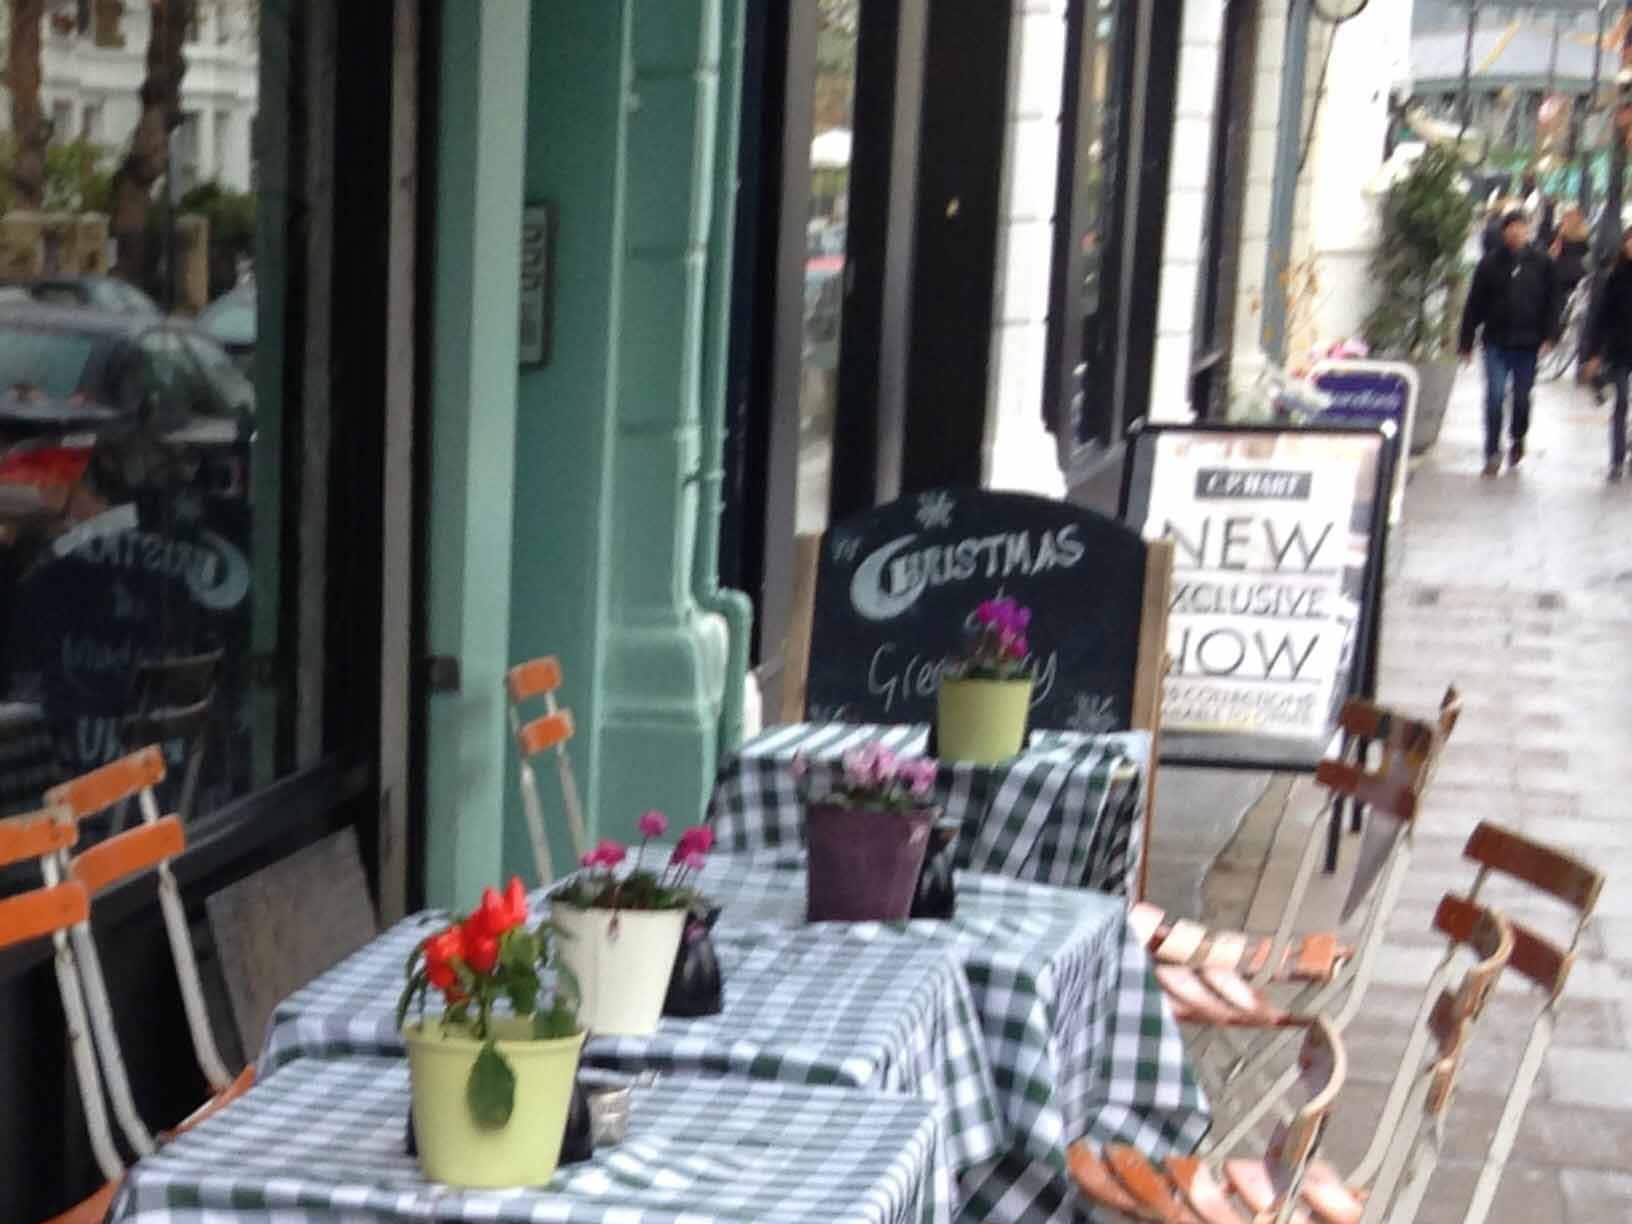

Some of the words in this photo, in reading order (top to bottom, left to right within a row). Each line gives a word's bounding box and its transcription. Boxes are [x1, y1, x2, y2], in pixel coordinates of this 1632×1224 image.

[1162, 515, 1335, 571] NEW
[850, 523, 1086, 620] CHRISTMAS
[1168, 583, 1328, 617] XCLUSIVE
